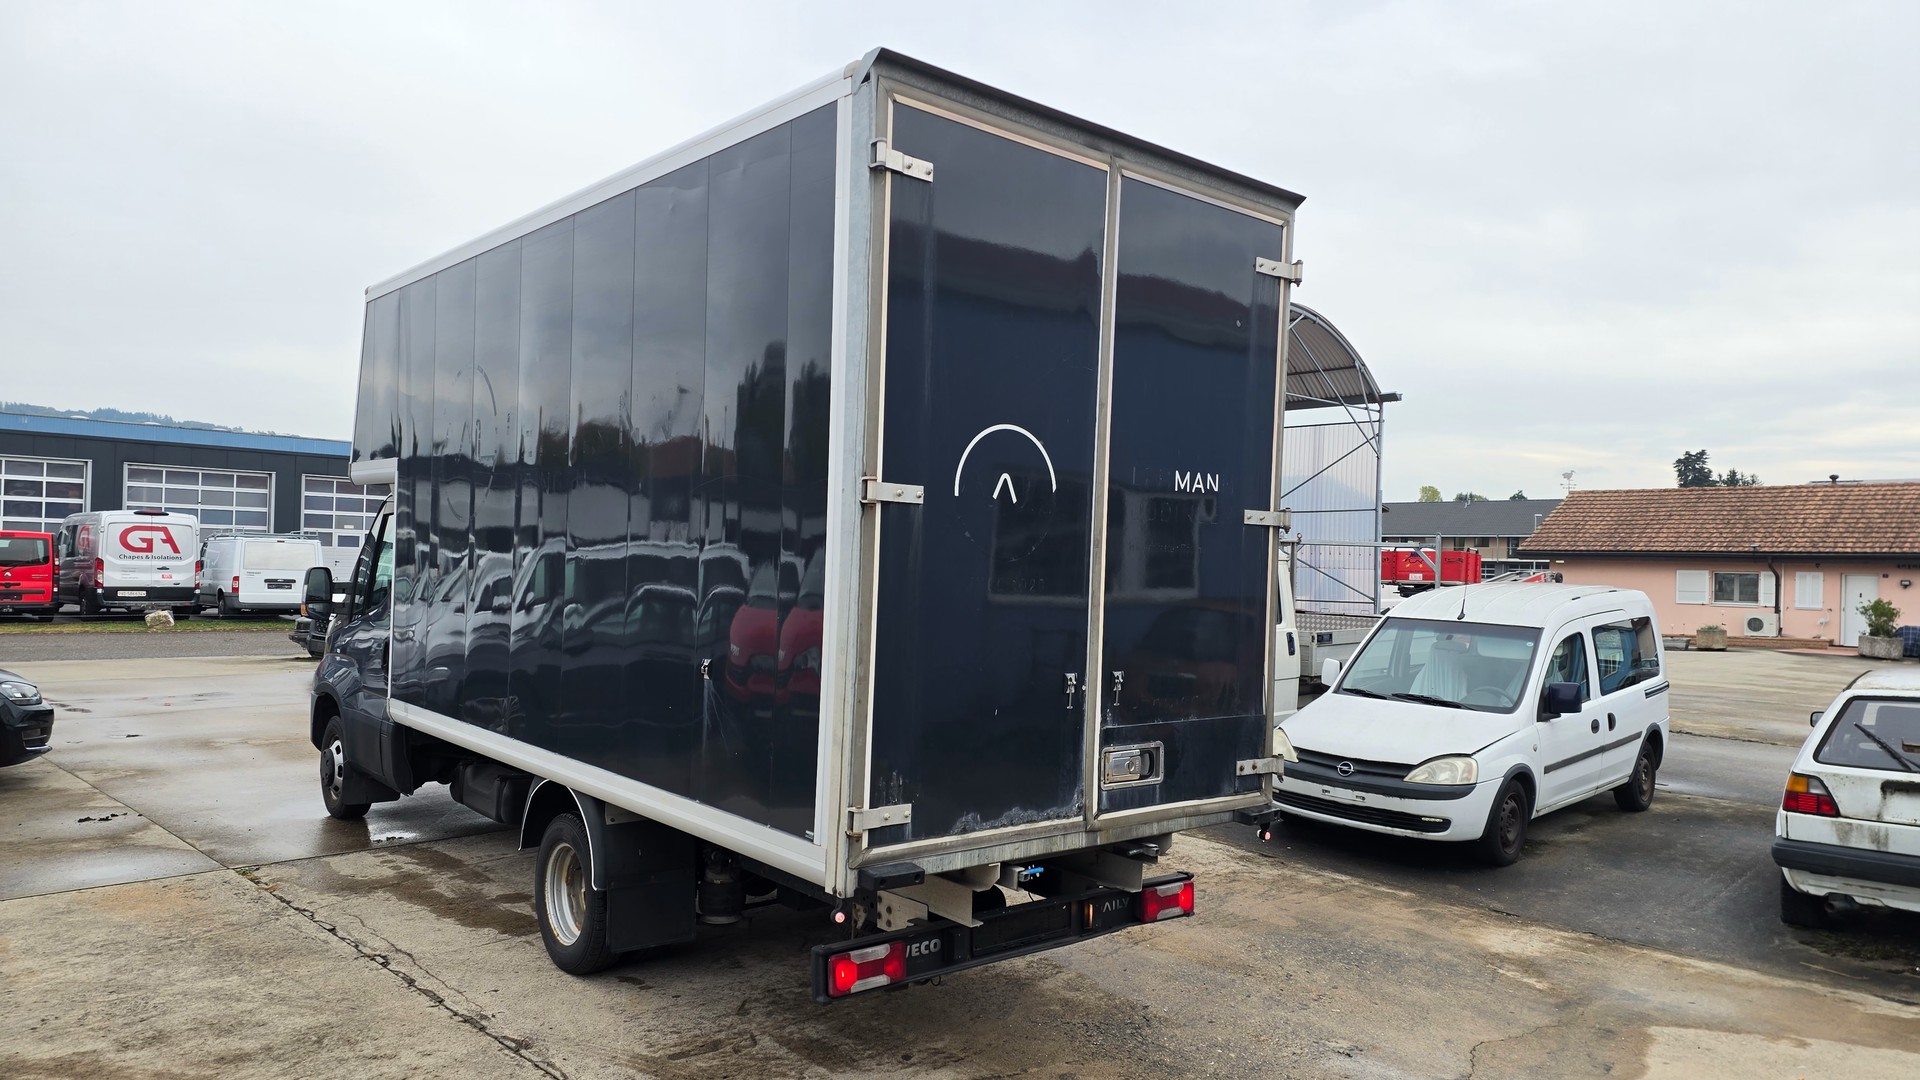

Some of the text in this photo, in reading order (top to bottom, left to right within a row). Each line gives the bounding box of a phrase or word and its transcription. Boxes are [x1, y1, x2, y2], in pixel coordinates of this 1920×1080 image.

[1174, 469, 1219, 494] MAN
[119, 525, 181, 554] GA
[118, 553, 144, 561] Chapes
[1101, 897, 1129, 913] AILY
[905, 939, 941, 958] ECO
